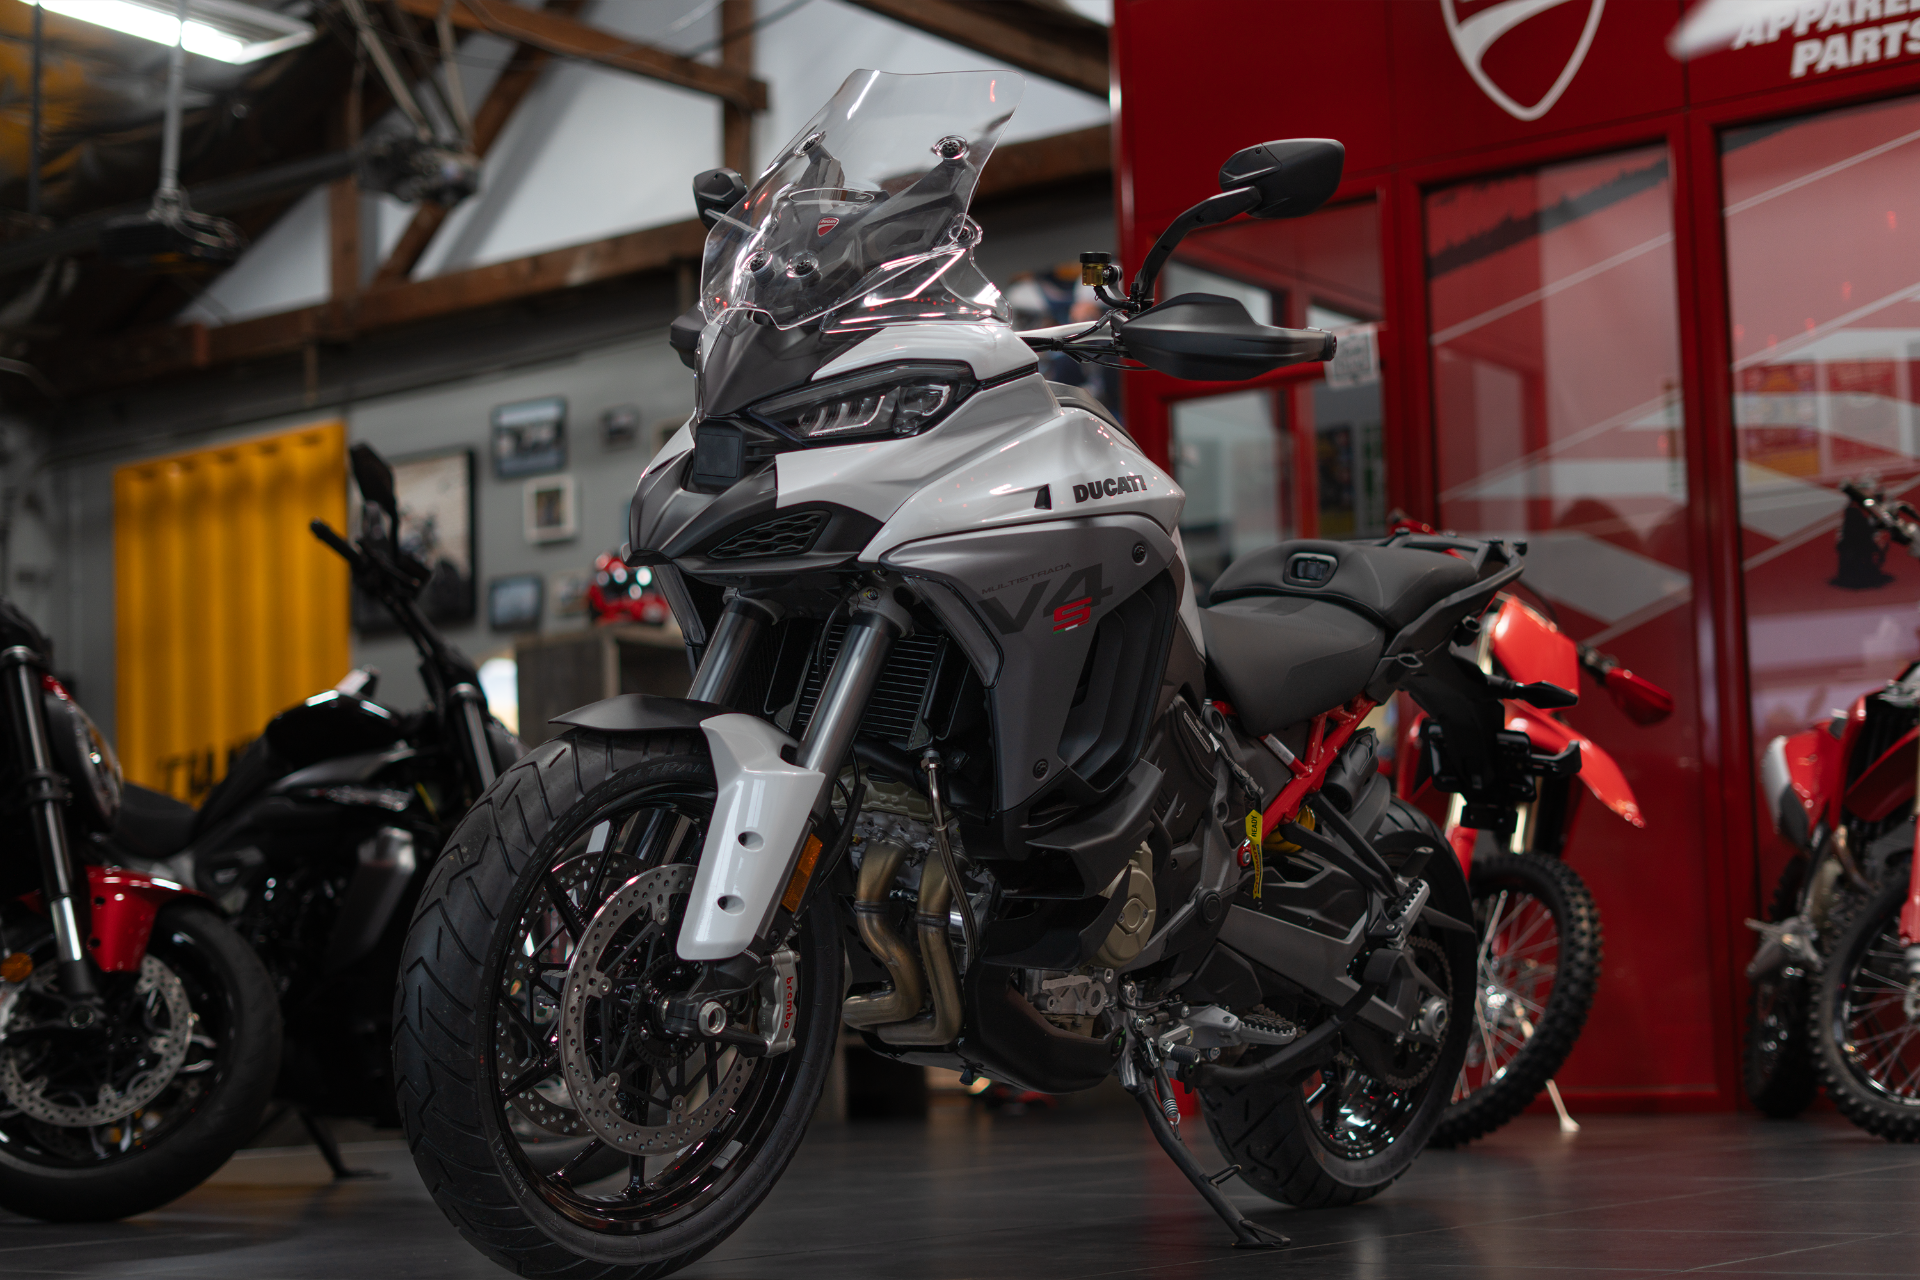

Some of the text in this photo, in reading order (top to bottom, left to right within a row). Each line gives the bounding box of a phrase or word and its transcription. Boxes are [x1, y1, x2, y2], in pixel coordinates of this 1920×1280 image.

[1072, 475, 1148, 503] DUCATI
[981, 562, 1072, 595] MULTISTRADA
[783, 976, 794, 1029] brembo
